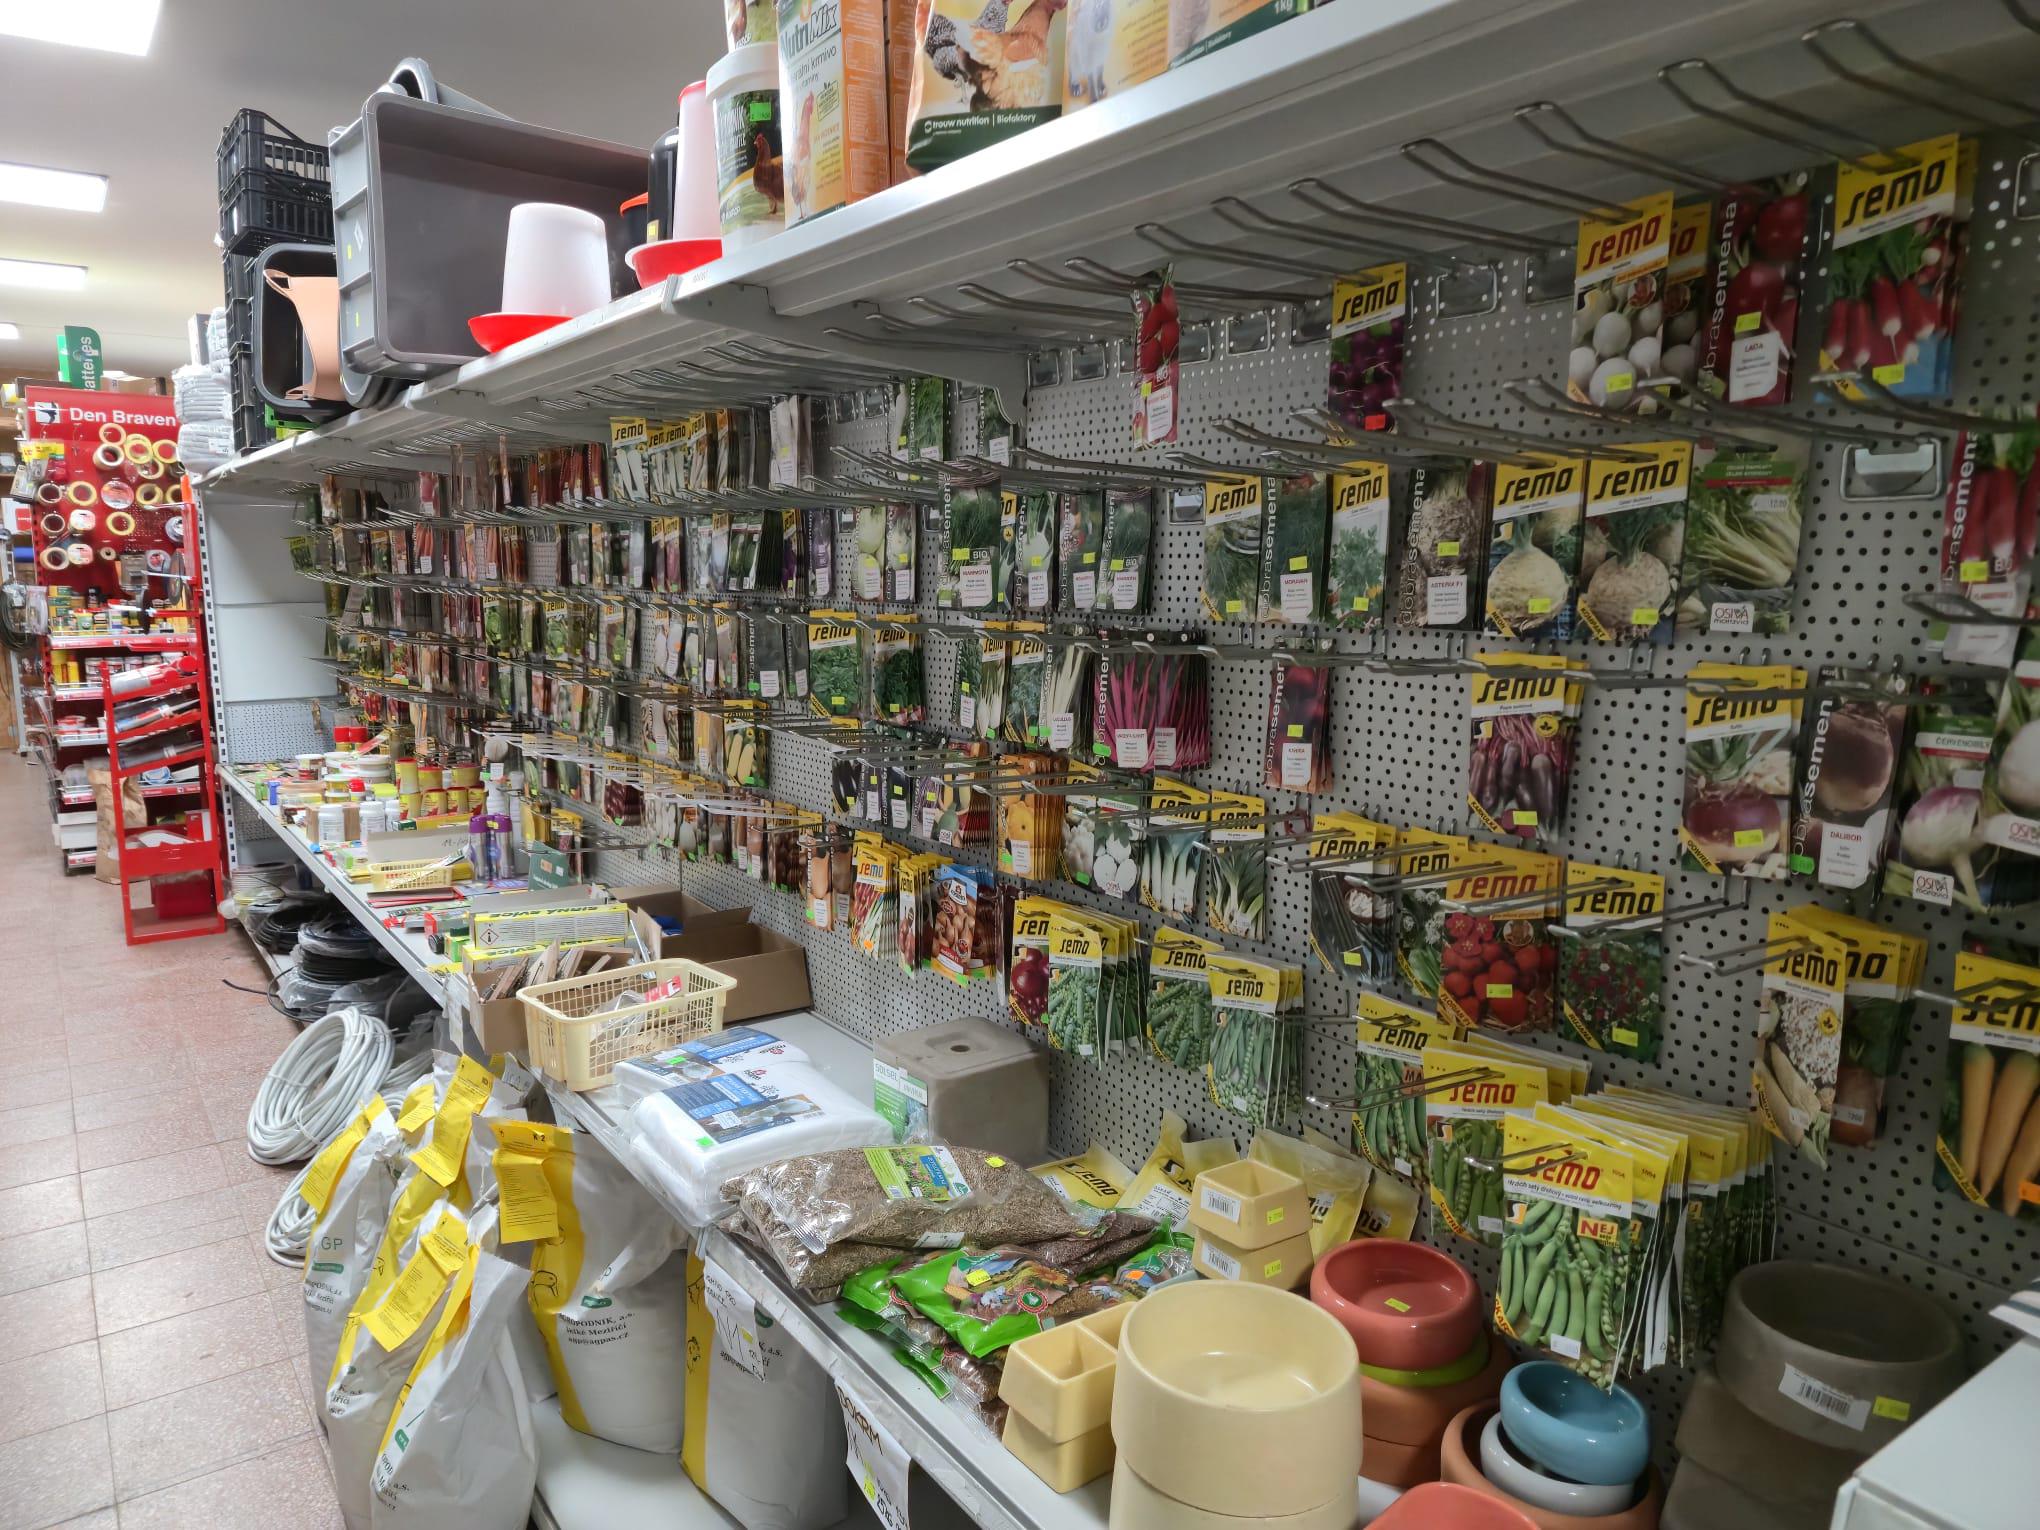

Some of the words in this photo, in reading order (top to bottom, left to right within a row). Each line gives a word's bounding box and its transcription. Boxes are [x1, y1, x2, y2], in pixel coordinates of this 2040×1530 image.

[779, 3, 839, 59] NutriMix
[932, 119, 955, 130] trouw
[956, 115, 990, 128] nutrition
[996, 111, 1036, 125] Biofaktory
[1842, 158, 1946, 229] semo
[1583, 214, 1662, 271] semo
[1336, 279, 1399, 323] semo
[69, 407, 112, 423] Den
[115, 410, 176, 427] Braven
[614, 423, 643, 441] semo
[1336, 475, 1382, 511] semo
[1498, 467, 1574, 505] semo
[1594, 460, 1679, 501] semo
[1209, 483, 1257, 515] semo
[1401, 468, 1425, 625] dobrasemena
[1477, 677, 1556, 704] semo
[1471, 800, 1499, 831] KARKULKA
[1406, 853, 1450, 875] sem
[1453, 874, 1538, 900] semo
[1573, 890, 1657, 916] semo
[1017, 920, 1049, 935] sem
[1060, 938, 1089, 955] semo
[1164, 949, 1207, 969] semo
[1779, 948, 1838, 987] semo
[1226, 979, 1264, 998] semo
[1375, 1025, 1429, 1051] semo
[1568, 1013, 1593, 1042] RUJANA
[1449, 1081, 1517, 1105] semo
[1076, 1167, 1118, 1197] semo
[1580, 1219, 1616, 1236] NEJ
[320, 1236, 343, 1251] GP
